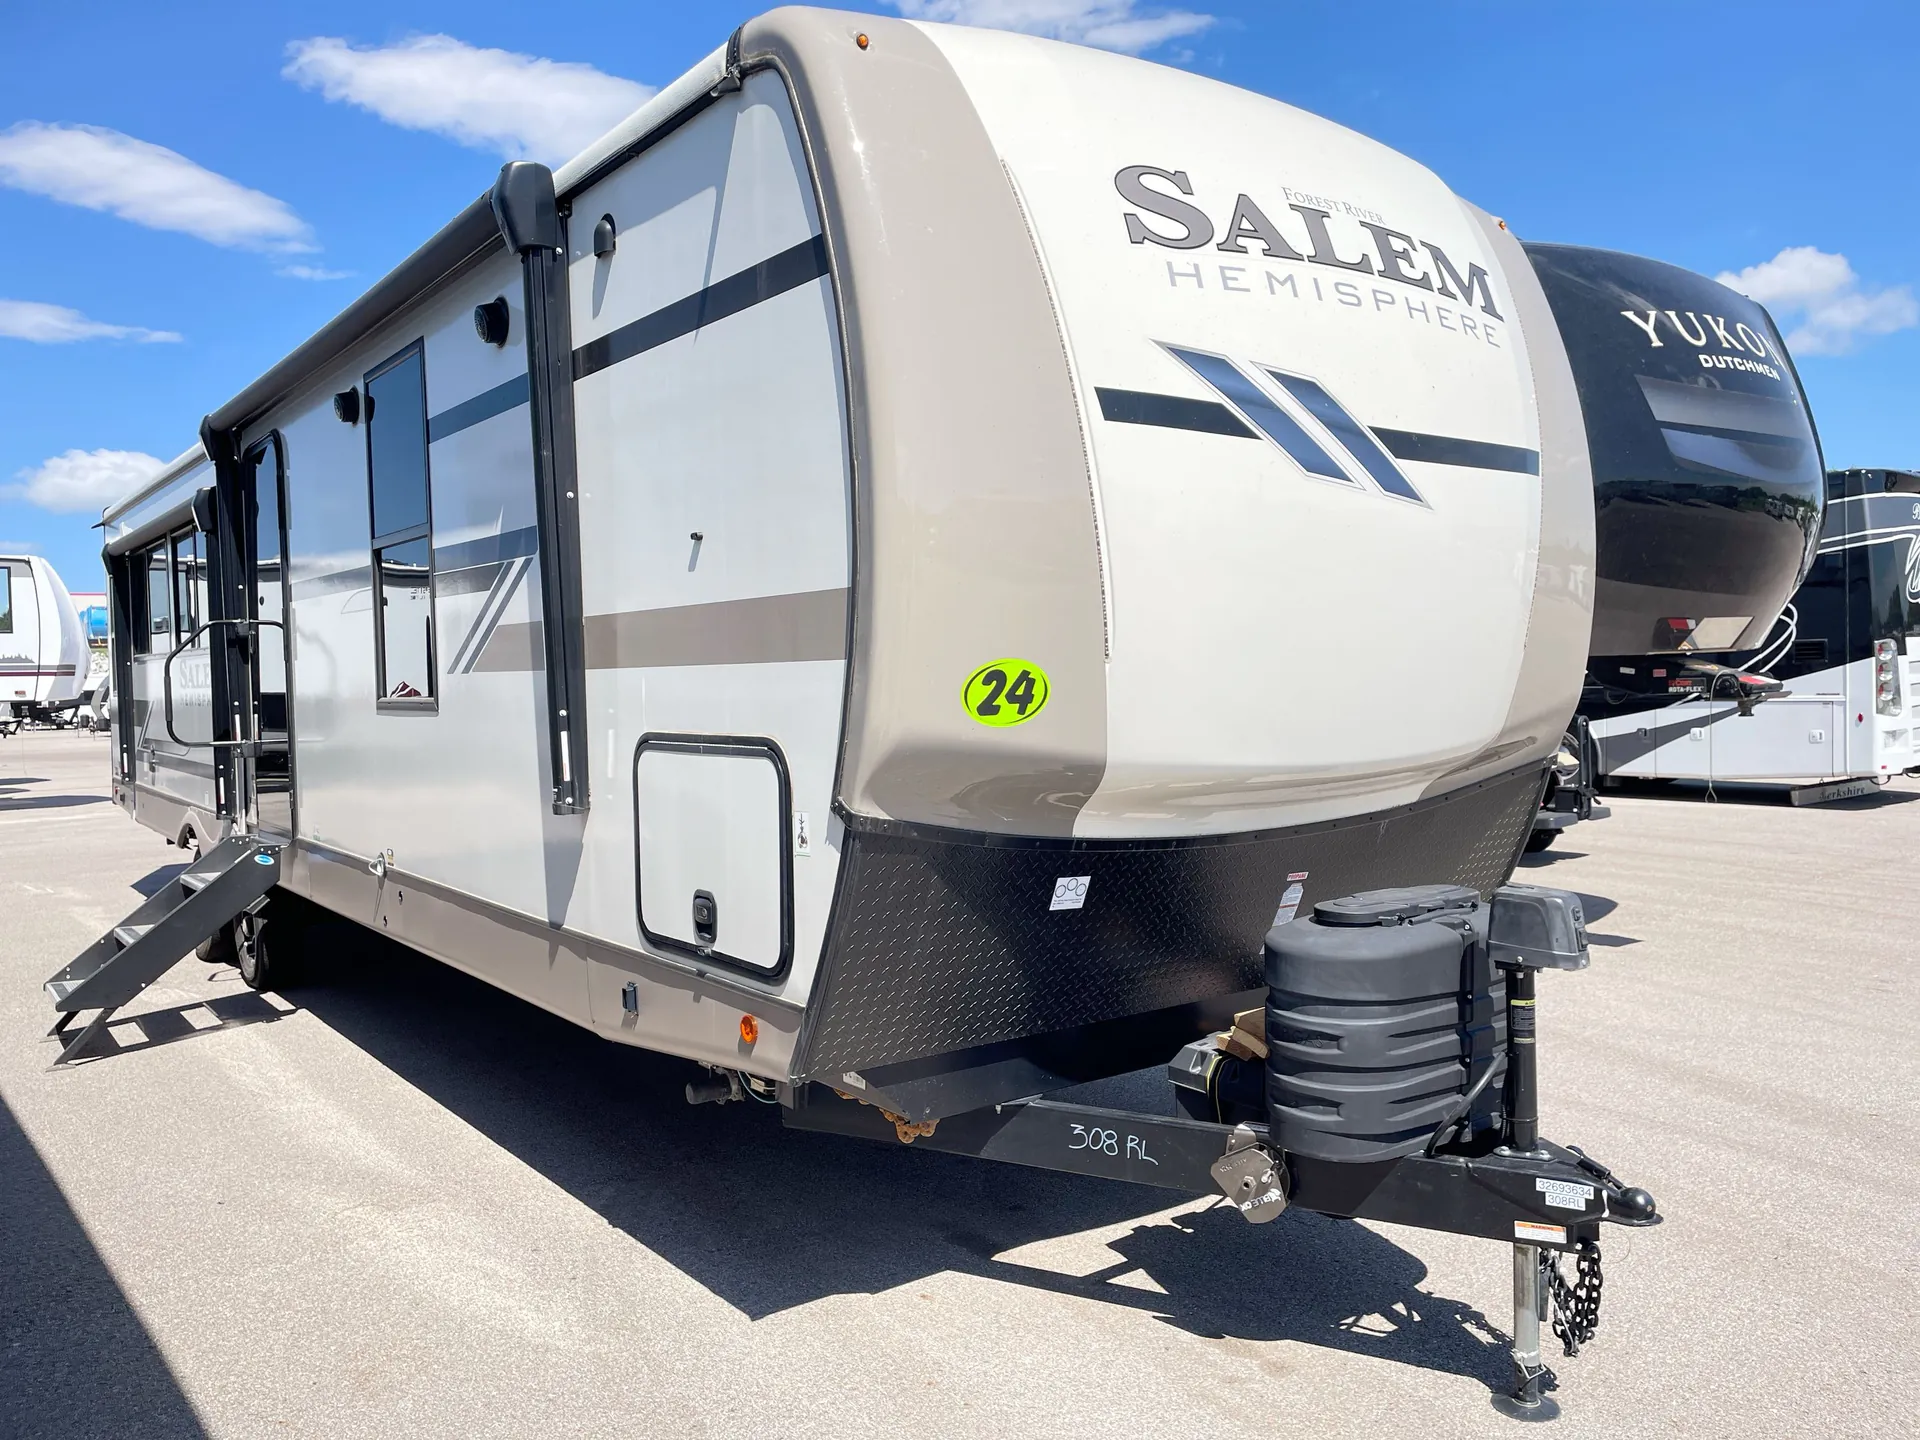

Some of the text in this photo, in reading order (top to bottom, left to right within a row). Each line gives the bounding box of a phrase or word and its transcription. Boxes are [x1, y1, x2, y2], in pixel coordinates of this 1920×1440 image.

[1281, 186, 1387, 226] FOREST RIVER
[1114, 165, 1504, 322] SALEM
[1166, 261, 1501, 348] HEMISPHERE
[1620, 310, 1787, 373] YUKON
[1698, 354, 1781, 381] DUTCHMEN
[180, 659, 211, 689] SALE
[976, 669, 1036, 716] 24
[1068, 1123, 1159, 1166] 308 RL
[1538, 1180, 1592, 1197] 32693634
[1547, 1194, 1584, 1208] 308RL
